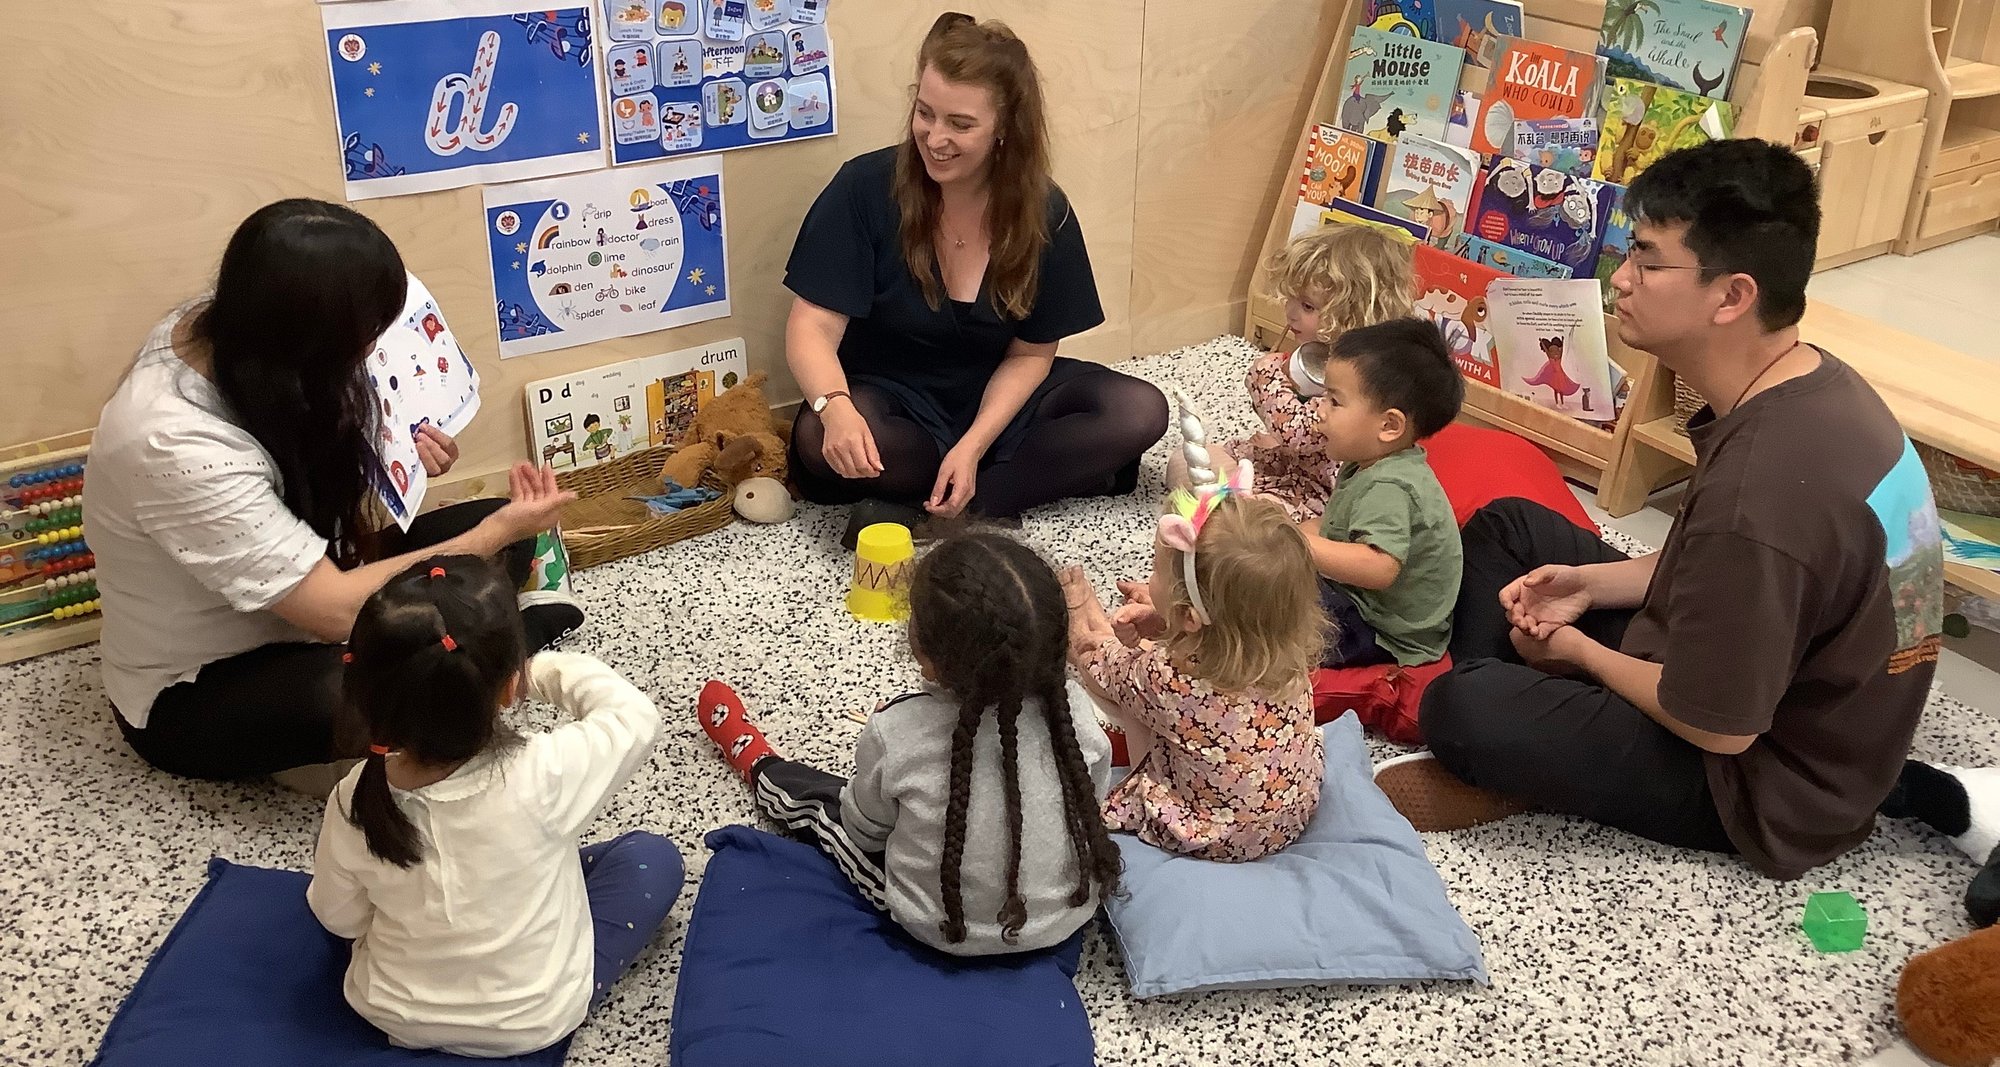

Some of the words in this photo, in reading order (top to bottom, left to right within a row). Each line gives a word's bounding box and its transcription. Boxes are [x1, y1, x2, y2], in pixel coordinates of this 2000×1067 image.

[1653, 19, 1671, 35] The
[1673, 22, 1704, 43] Snail
[703, 45, 745, 58] Afternoon
[1384, 42, 1422, 59] Little
[712, 56, 734, 69] 下午
[1648, 46, 1690, 69] Whale
[1503, 83, 1529, 101] WHO
[1533, 90, 1574, 113] COULD
[1315, 147, 1346, 176] MOO!
[1337, 145, 1360, 165] CAN
[1311, 182, 1322, 190] CAN
[1306, 190, 1328, 201] YOU?
[650, 198, 668, 207] boat
[556, 204, 565, 218] 1
[593, 210, 612, 220] drip
[648, 215, 674, 228] dress
[551, 237, 591, 250] rainbow
[607, 233, 640, 244] doctor
[660, 237, 680, 247] rain
[604, 252, 626, 263] lime
[547, 263, 582, 276] dolphin
[631, 262, 675, 278] dinosaur
[574, 282, 594, 292] den
[625, 285, 646, 296] bike
[638, 300, 657, 312] leaf
[575, 307, 605, 321] spider
[700, 348, 738, 366] drum
[1455, 356, 1482, 376] WITH
[1483, 370, 1492, 380] A
[539, 387, 553, 404] D
[561, 382, 572, 399] d
